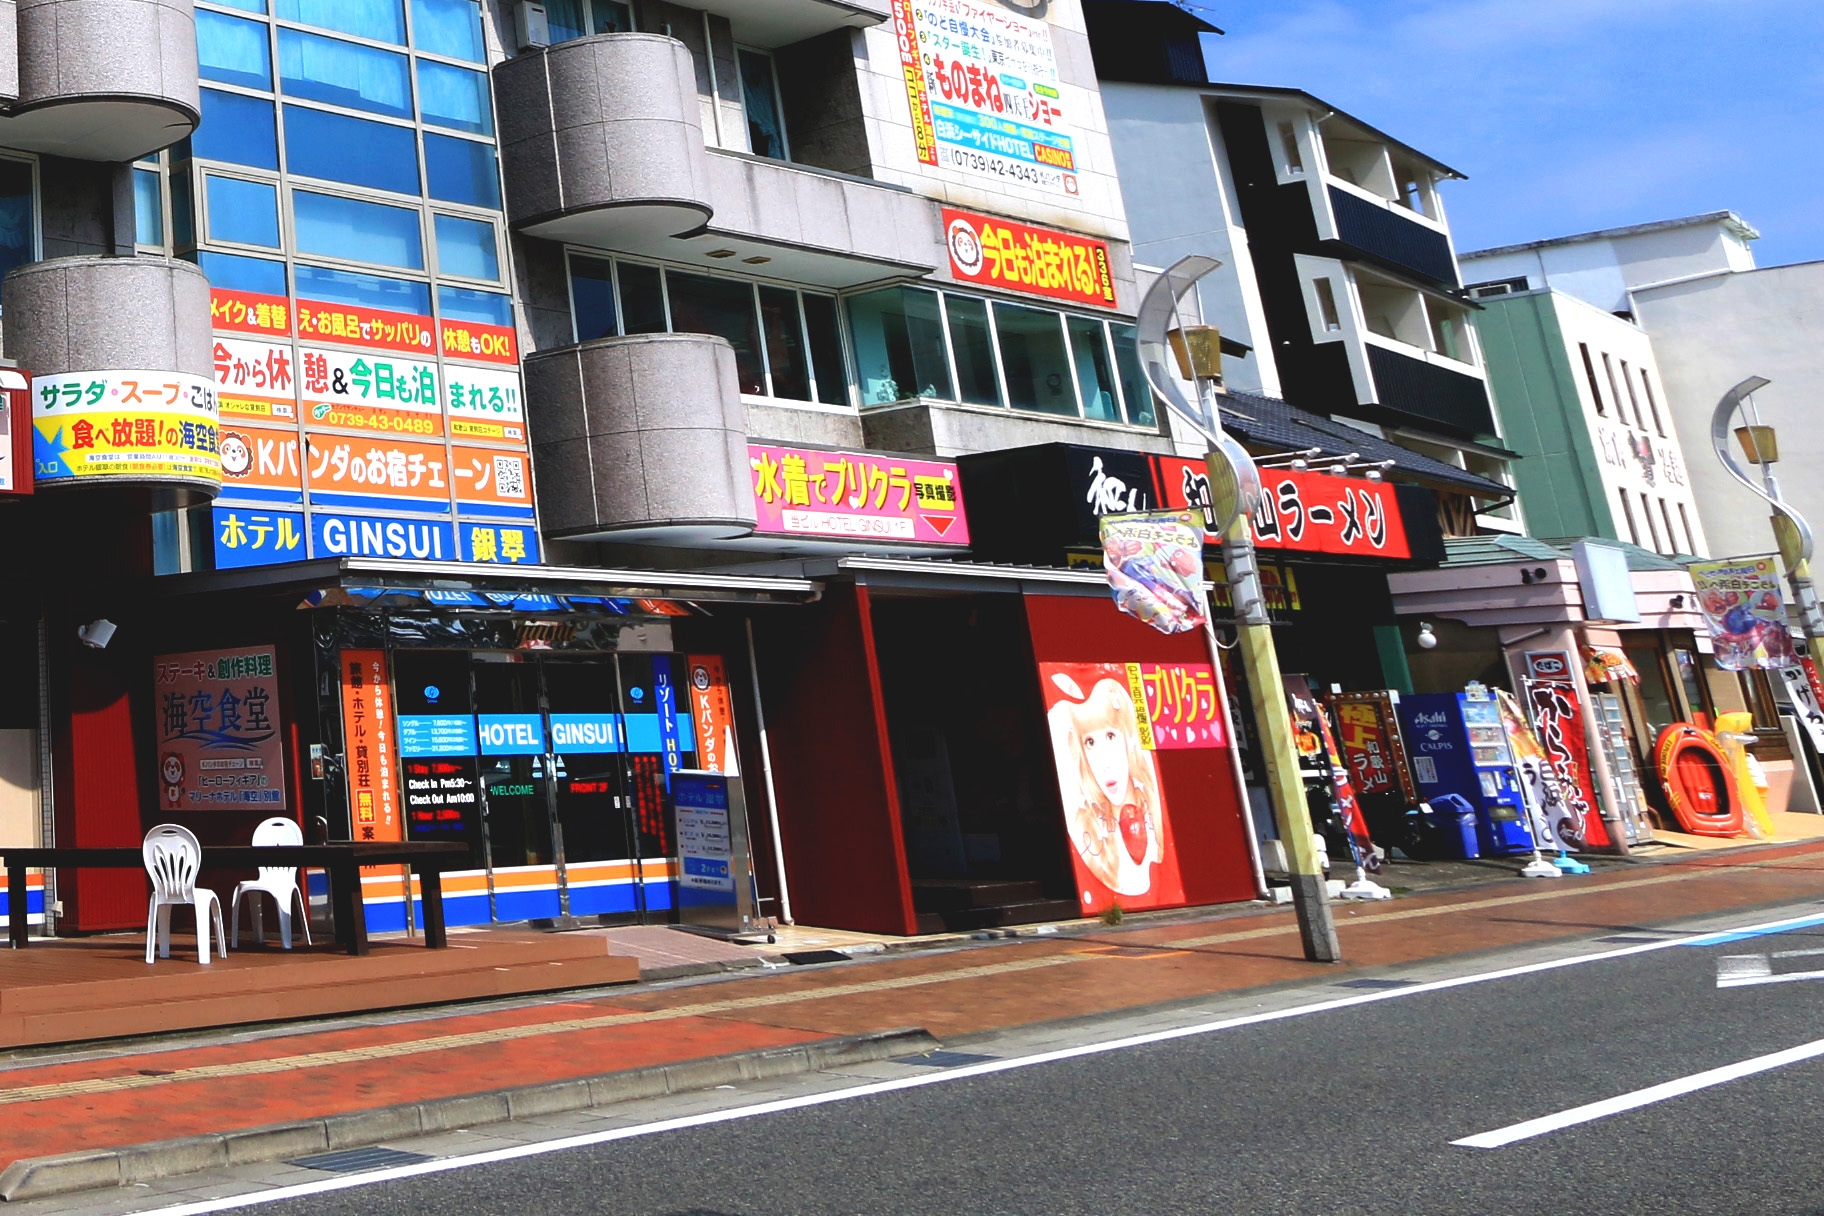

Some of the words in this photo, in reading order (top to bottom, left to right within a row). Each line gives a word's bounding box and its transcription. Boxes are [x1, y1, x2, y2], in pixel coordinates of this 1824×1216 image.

[980, 223, 1101, 295] 今日も泊まれる!
[329, 411, 433, 434] 0739-43-0489
[38, 461, 58, 474] 入口
[754, 452, 911, 511] 水着でプリクラ
[914, 482, 956, 502] 写真撮影
[821, 517, 854, 531] HOTEL
[858, 519, 892, 534] GINSUI
[220, 514, 301, 552] ホテル
[323, 519, 442, 559] GINSUI
[470, 527, 526, 563] 銀翠
[157, 654, 273, 684] ステーキ&創作料理
[659, 674, 674, 733] リゾート
[1127, 665, 1152, 745] 写真撮影
[1143, 665, 1217, 724] プリクラ
[162, 686, 273, 737] 海空食堂
[1415, 711, 1447, 724] Asahi
[478, 723, 539, 746] HOTEL
[552, 722, 614, 744] GINSUI
[1420, 742, 1453, 752] CALPIS
[1366, 741, 1388, 784] 和歌山
[408, 779, 430, 789] Check
[431, 779, 438, 789] In
[491, 785, 534, 796] WELCOME
[359, 792, 374, 821] 無料
[410, 795, 431, 805] Check
[432, 794, 444, 804] Out
[446, 793, 475, 804] Am10:00
[678, 791, 702, 803] ホテル
